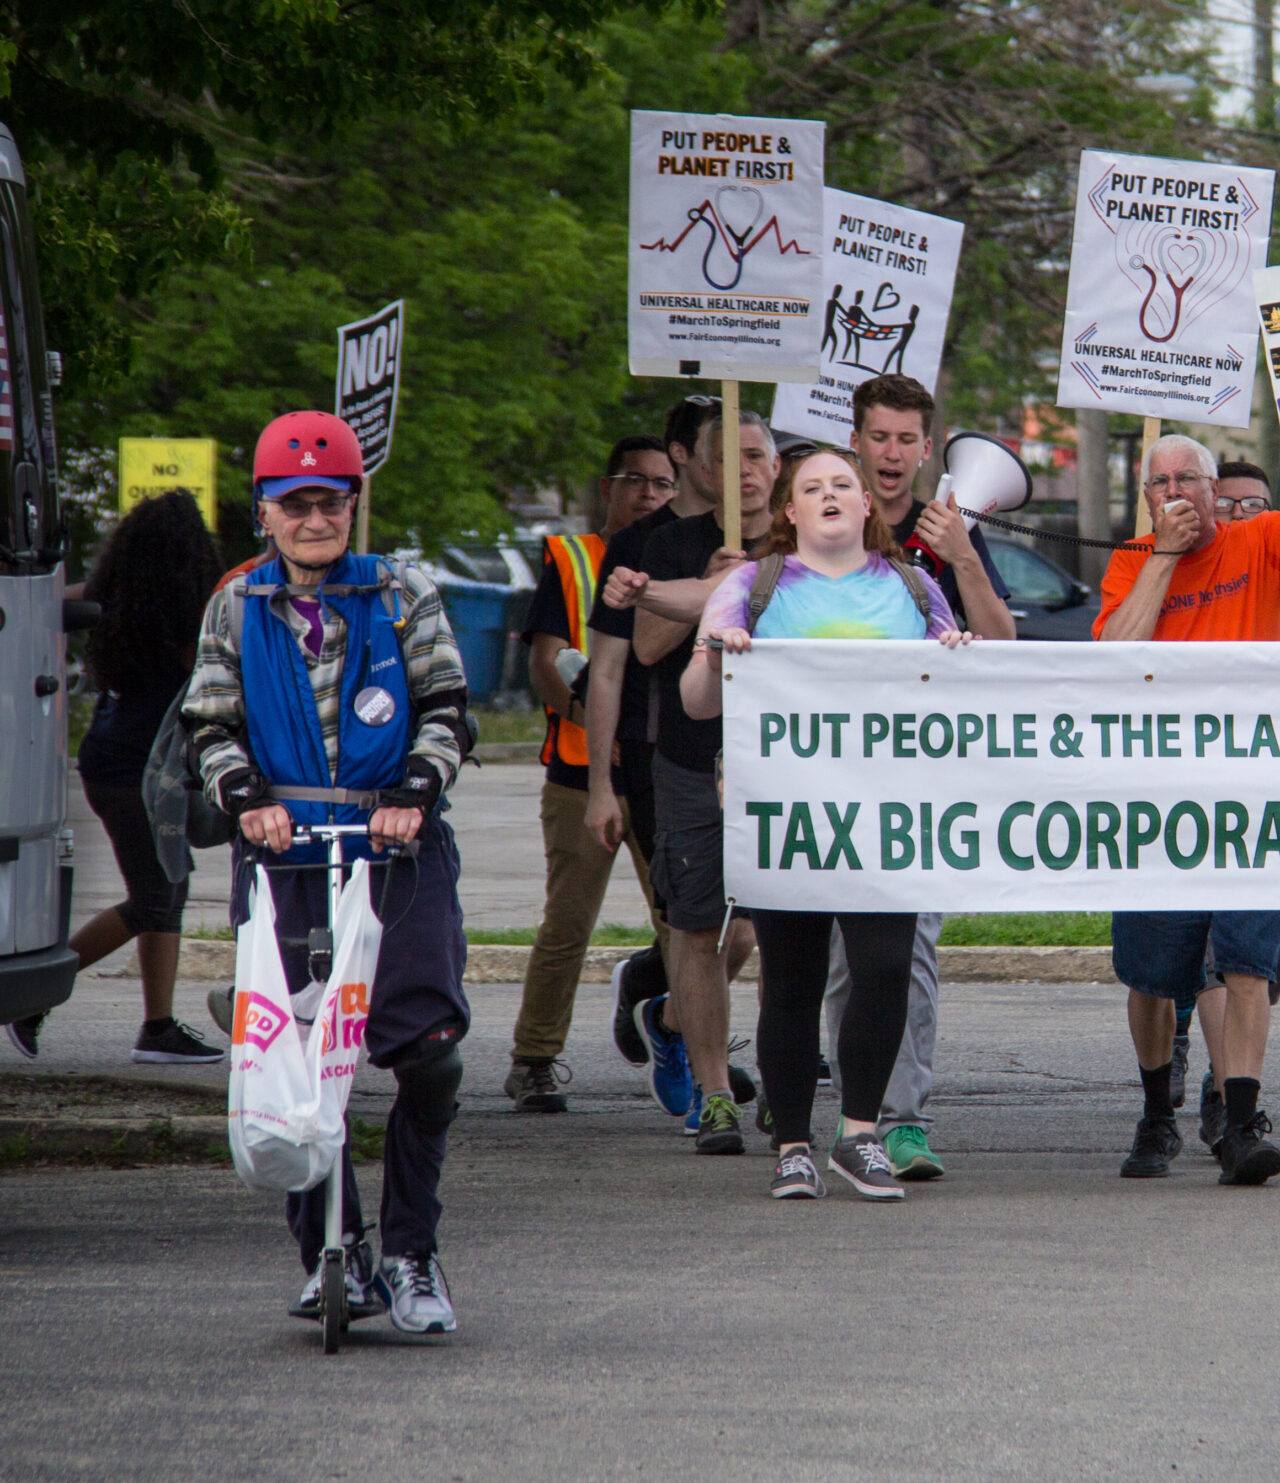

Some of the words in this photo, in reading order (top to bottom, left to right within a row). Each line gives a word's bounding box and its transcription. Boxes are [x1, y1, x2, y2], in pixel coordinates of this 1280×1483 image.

[662, 131, 695, 150] PUT
[702, 132, 772, 154] PEOPLE
[777, 137, 792, 155] &
[658, 156, 729, 177] PLANET
[735, 161, 794, 181] FIRST!
[1111, 173, 1146, 194] PUT
[1152, 177, 1220, 201] PEOPLE
[1225, 185, 1239, 204] &
[1106, 200, 1176, 223] PLANET
[1182, 208, 1239, 231] FIRST!
[838, 214, 865, 236] PUT
[867, 222, 916, 249] PEOPLE
[918, 235, 929, 253] &
[833, 237, 883, 266] PLANET
[885, 246, 927, 276] FIRST!
[640, 294, 704, 310] UNIVERSAL
[707, 298, 780, 314] HEALTHCARE
[782, 301, 810, 315] NOW
[668, 315, 781, 331] #MarchToSpringfield
[668, 332, 781, 347] www.FairEconomyIllinois.org
[343, 318, 397, 396] NO!
[1075, 343, 1137, 360] UNIVERSAL
[1141, 350, 1212, 369] HEALTHCARE
[1215, 357, 1242, 372] NOW
[837, 380, 858, 393] HUM
[1101, 365, 1212, 387] #MarchToSpringfield
[1100, 384, 1210, 404] www.FairEconomyIllinois.org
[152, 464, 179, 476] NO
[128, 486, 204, 499] OUTT
[371, 656, 397, 672] rmot
[760, 713, 850, 758] PUT
[863, 713, 1038, 758] PEOPLE
[1050, 713, 1086, 758] &
[1091, 713, 1182, 758] THE
[745, 801, 863, 871] TAX
[880, 800, 981, 871] BIG
